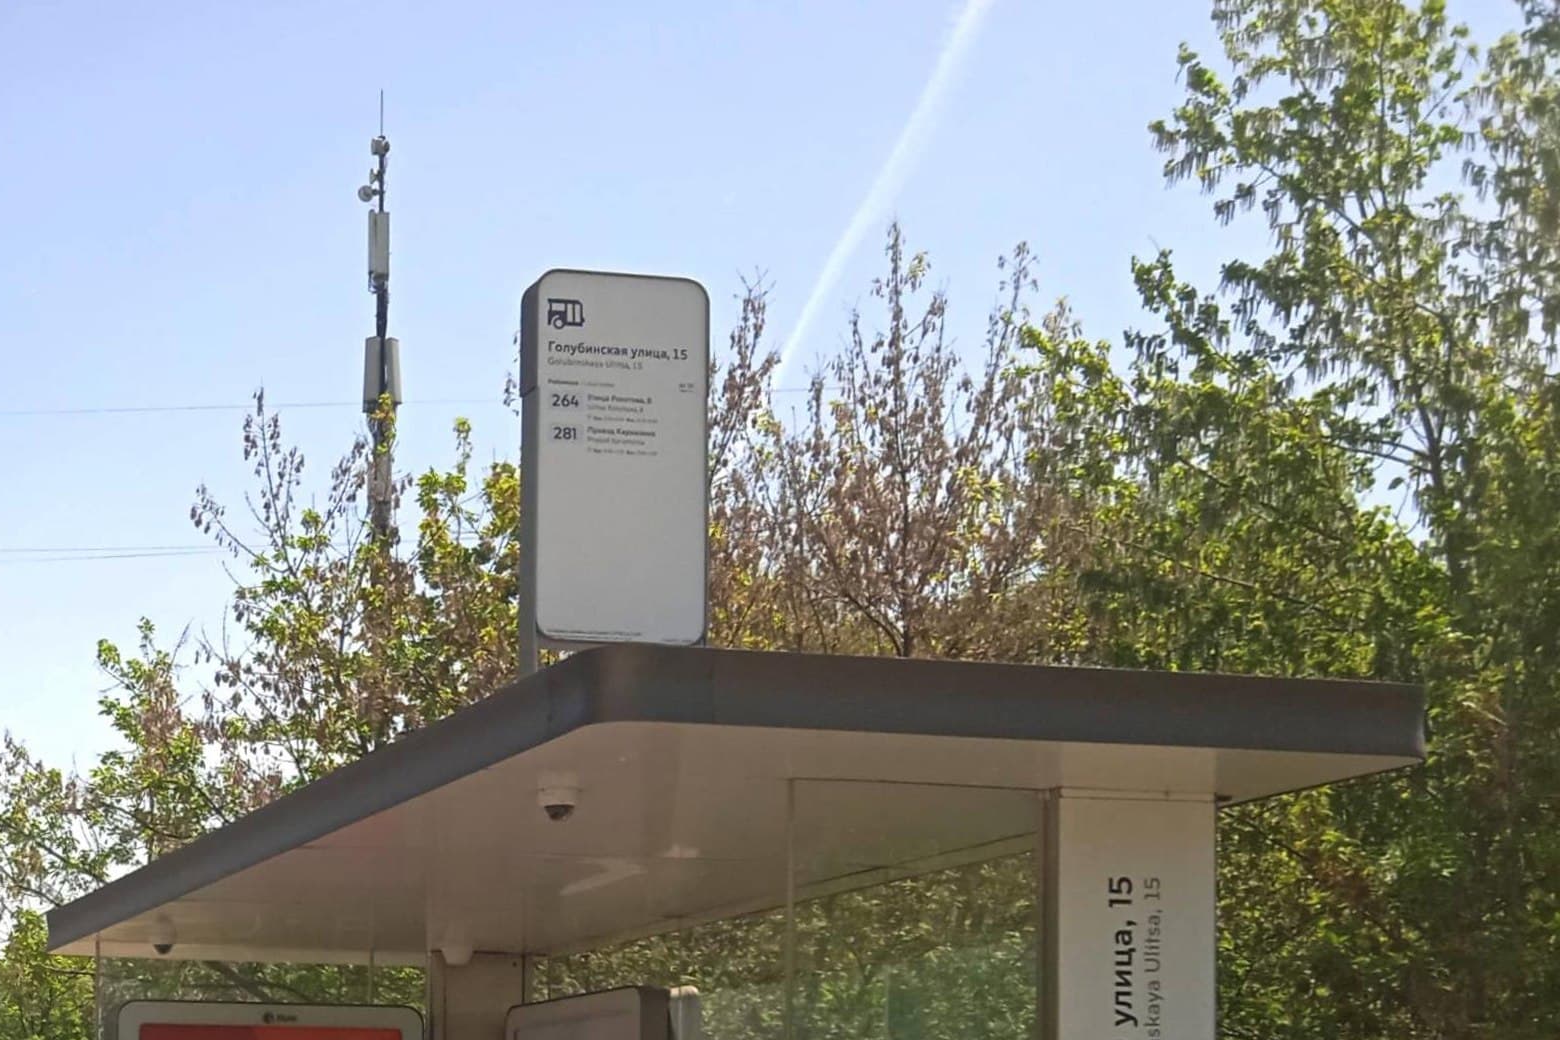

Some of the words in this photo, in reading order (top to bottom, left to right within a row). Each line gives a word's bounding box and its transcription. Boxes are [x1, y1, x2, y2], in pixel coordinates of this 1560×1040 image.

[547, 341, 628, 356] Голубинская
[631, 347, 670, 361] улица,
[672, 348, 688, 361] 15
[552, 393, 579, 407] 264
[553, 426, 577, 440] 281
[1108, 876, 1133, 908] 15
[1143, 877, 1161, 900] 15
[1143, 909, 1163, 973] Ulitsa,
[1114, 919, 1138, 1028] улица,
